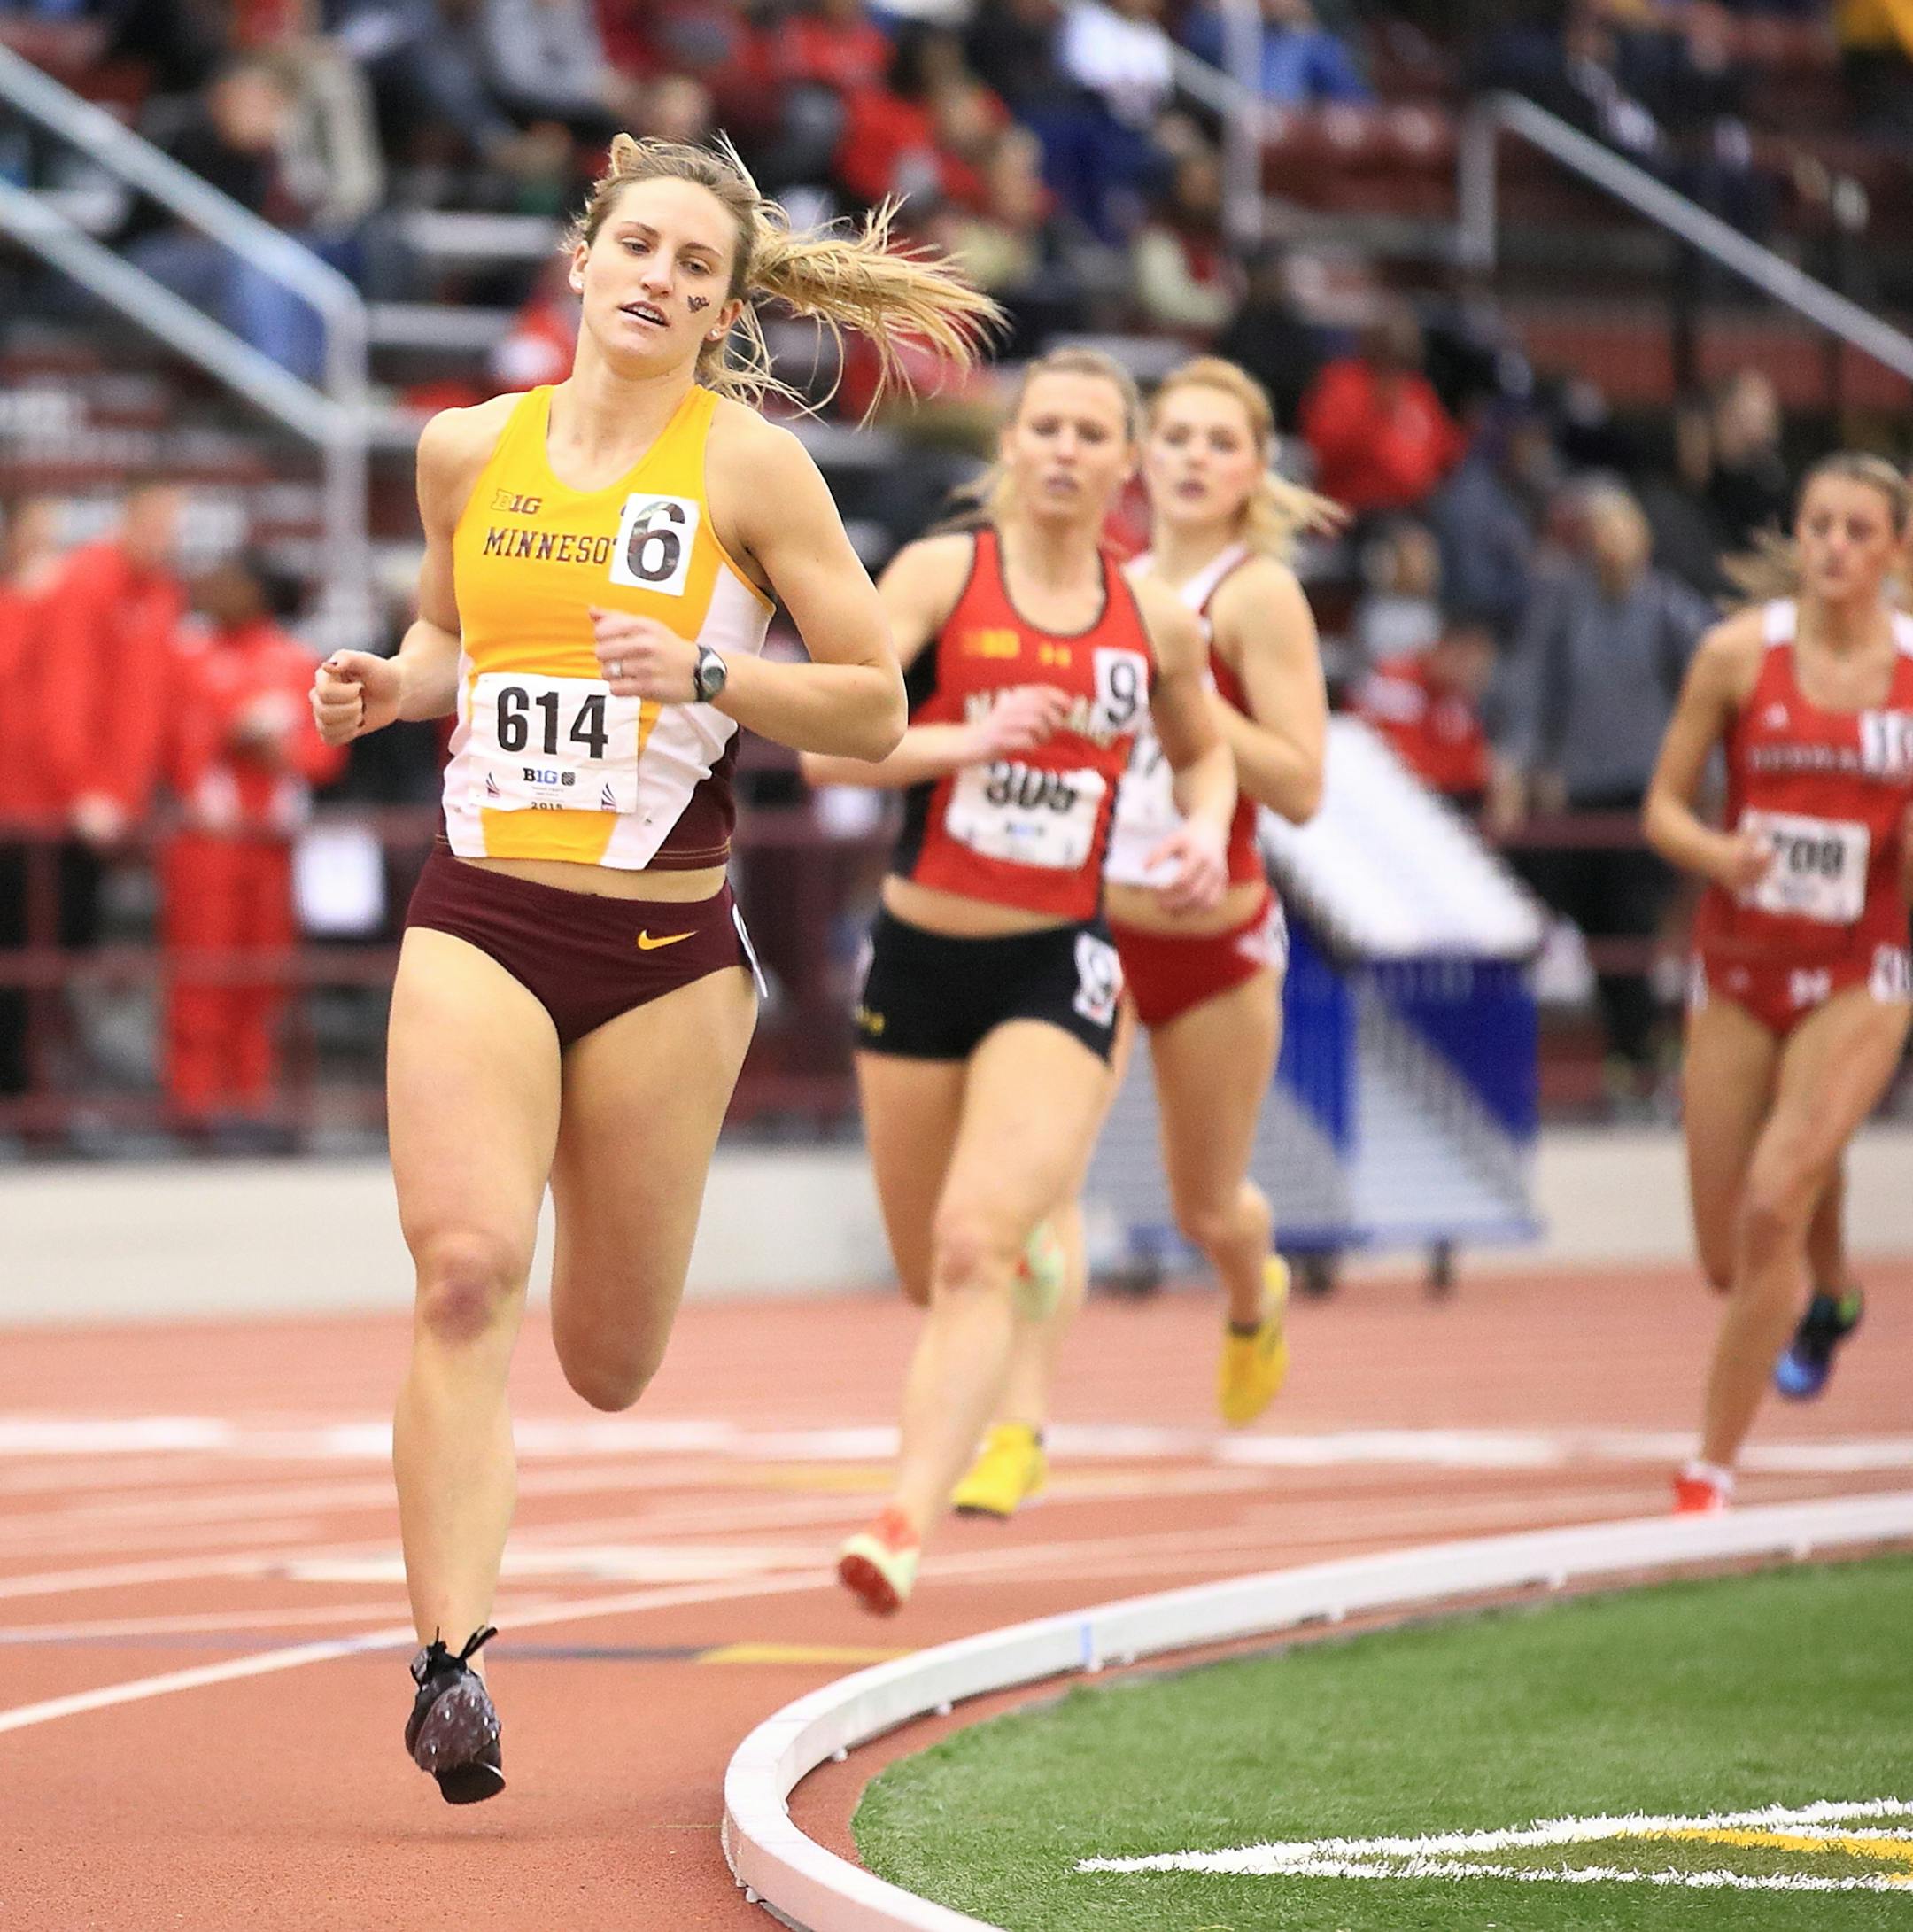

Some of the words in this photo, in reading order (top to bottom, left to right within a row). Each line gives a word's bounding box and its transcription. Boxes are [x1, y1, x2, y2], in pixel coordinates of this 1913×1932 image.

[483, 526, 618, 565] MINNESO
[626, 500, 686, 583] 6
[496, 686, 609, 760] 614
[1110, 657, 1137, 724] 9
